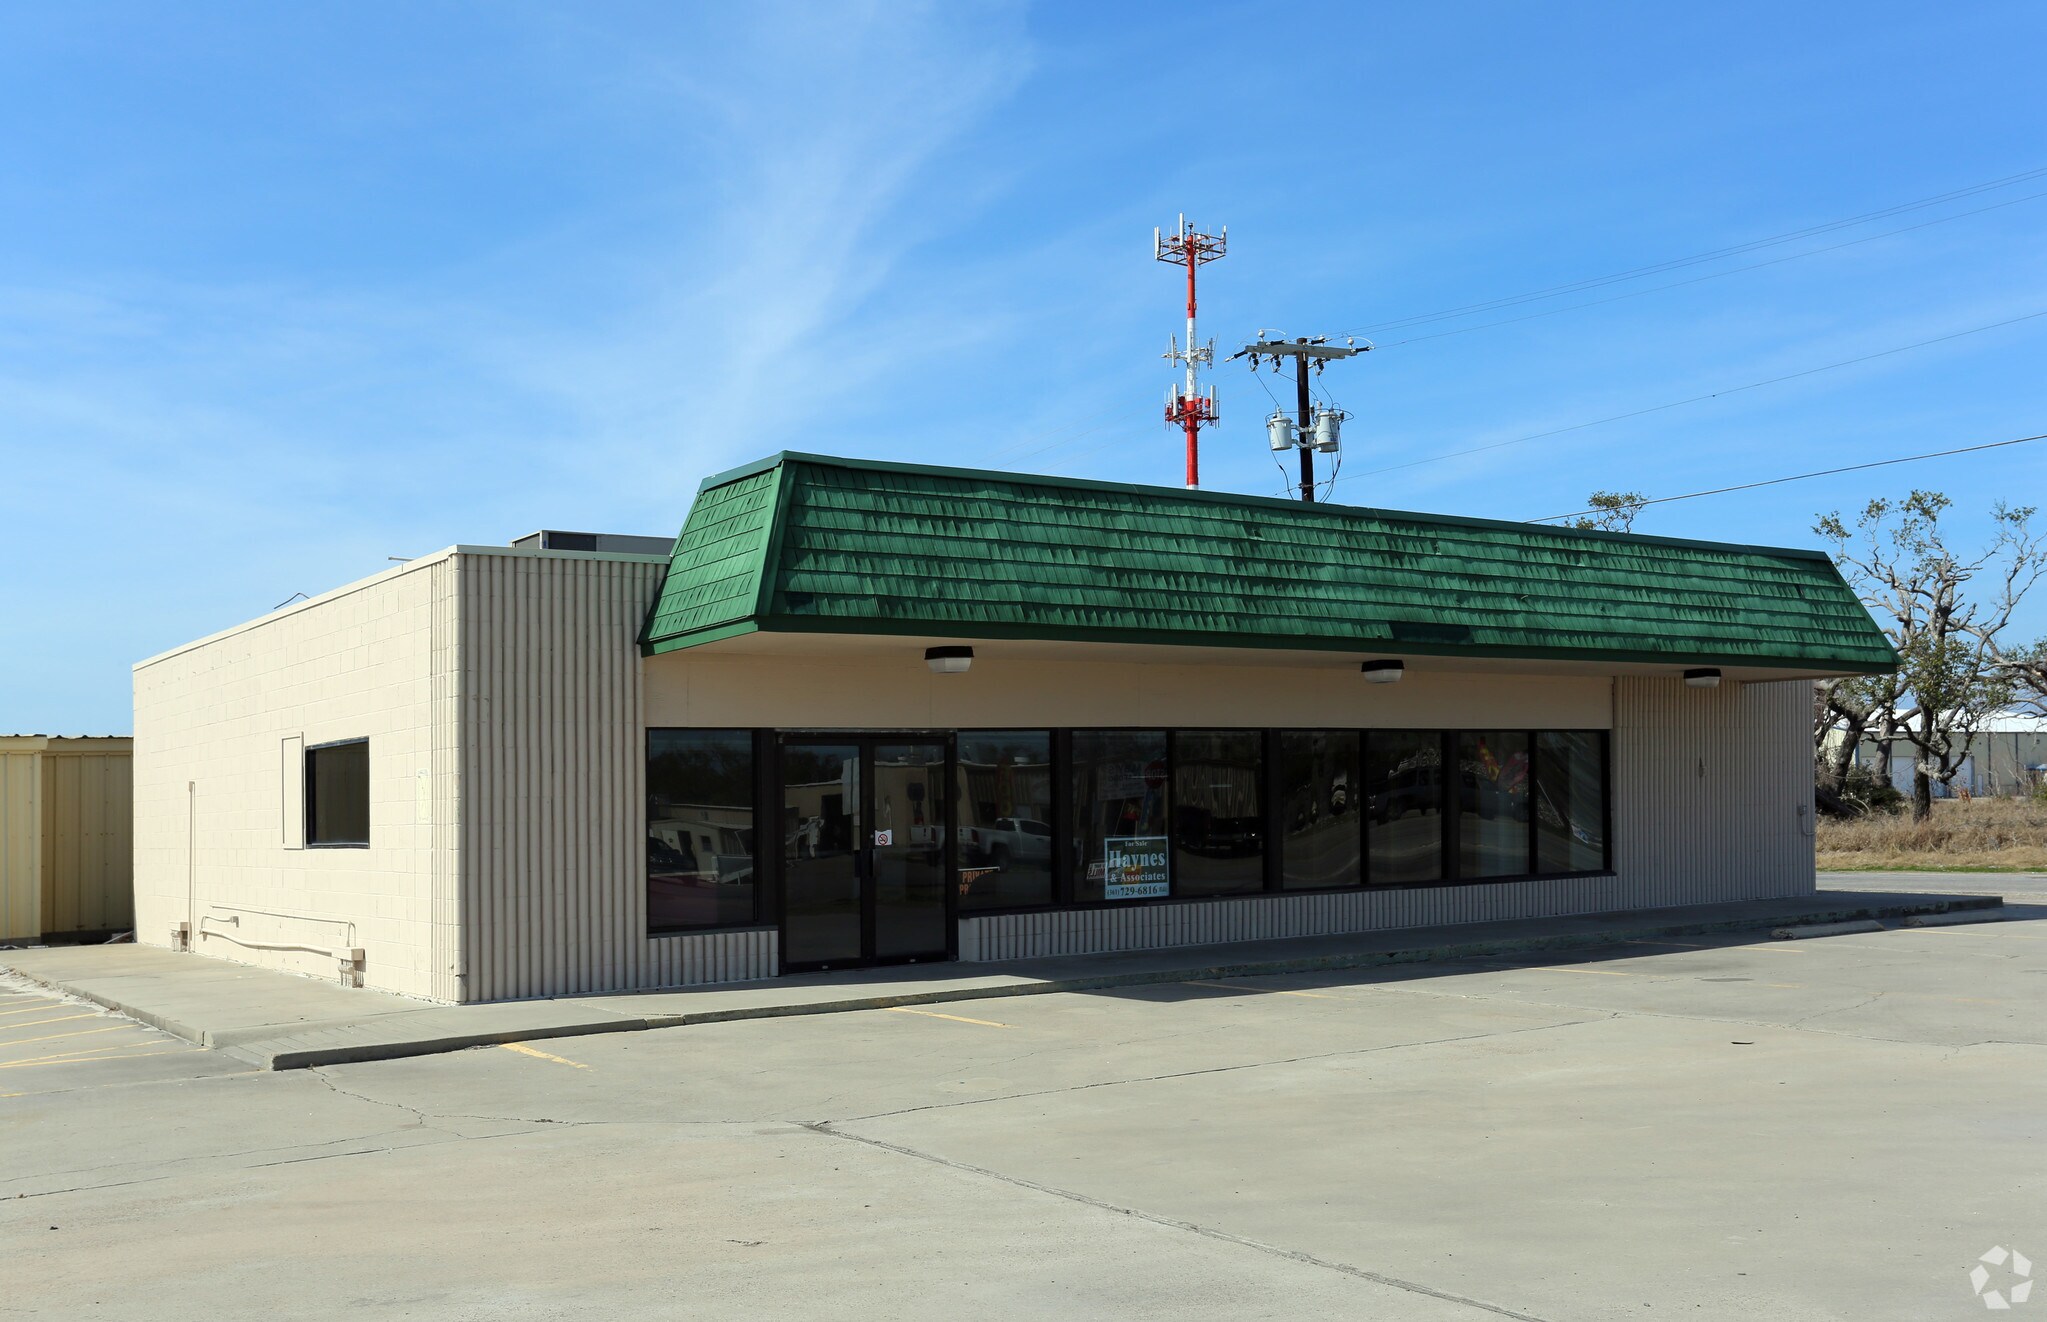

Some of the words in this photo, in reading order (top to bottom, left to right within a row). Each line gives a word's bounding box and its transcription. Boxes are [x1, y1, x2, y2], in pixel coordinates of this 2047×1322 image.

[1108, 850, 1166, 871] Haynes
[1110, 873, 1117, 883] &
[1120, 871, 1166, 882] Associates
[1120, 885, 1158, 896] 729-6816
